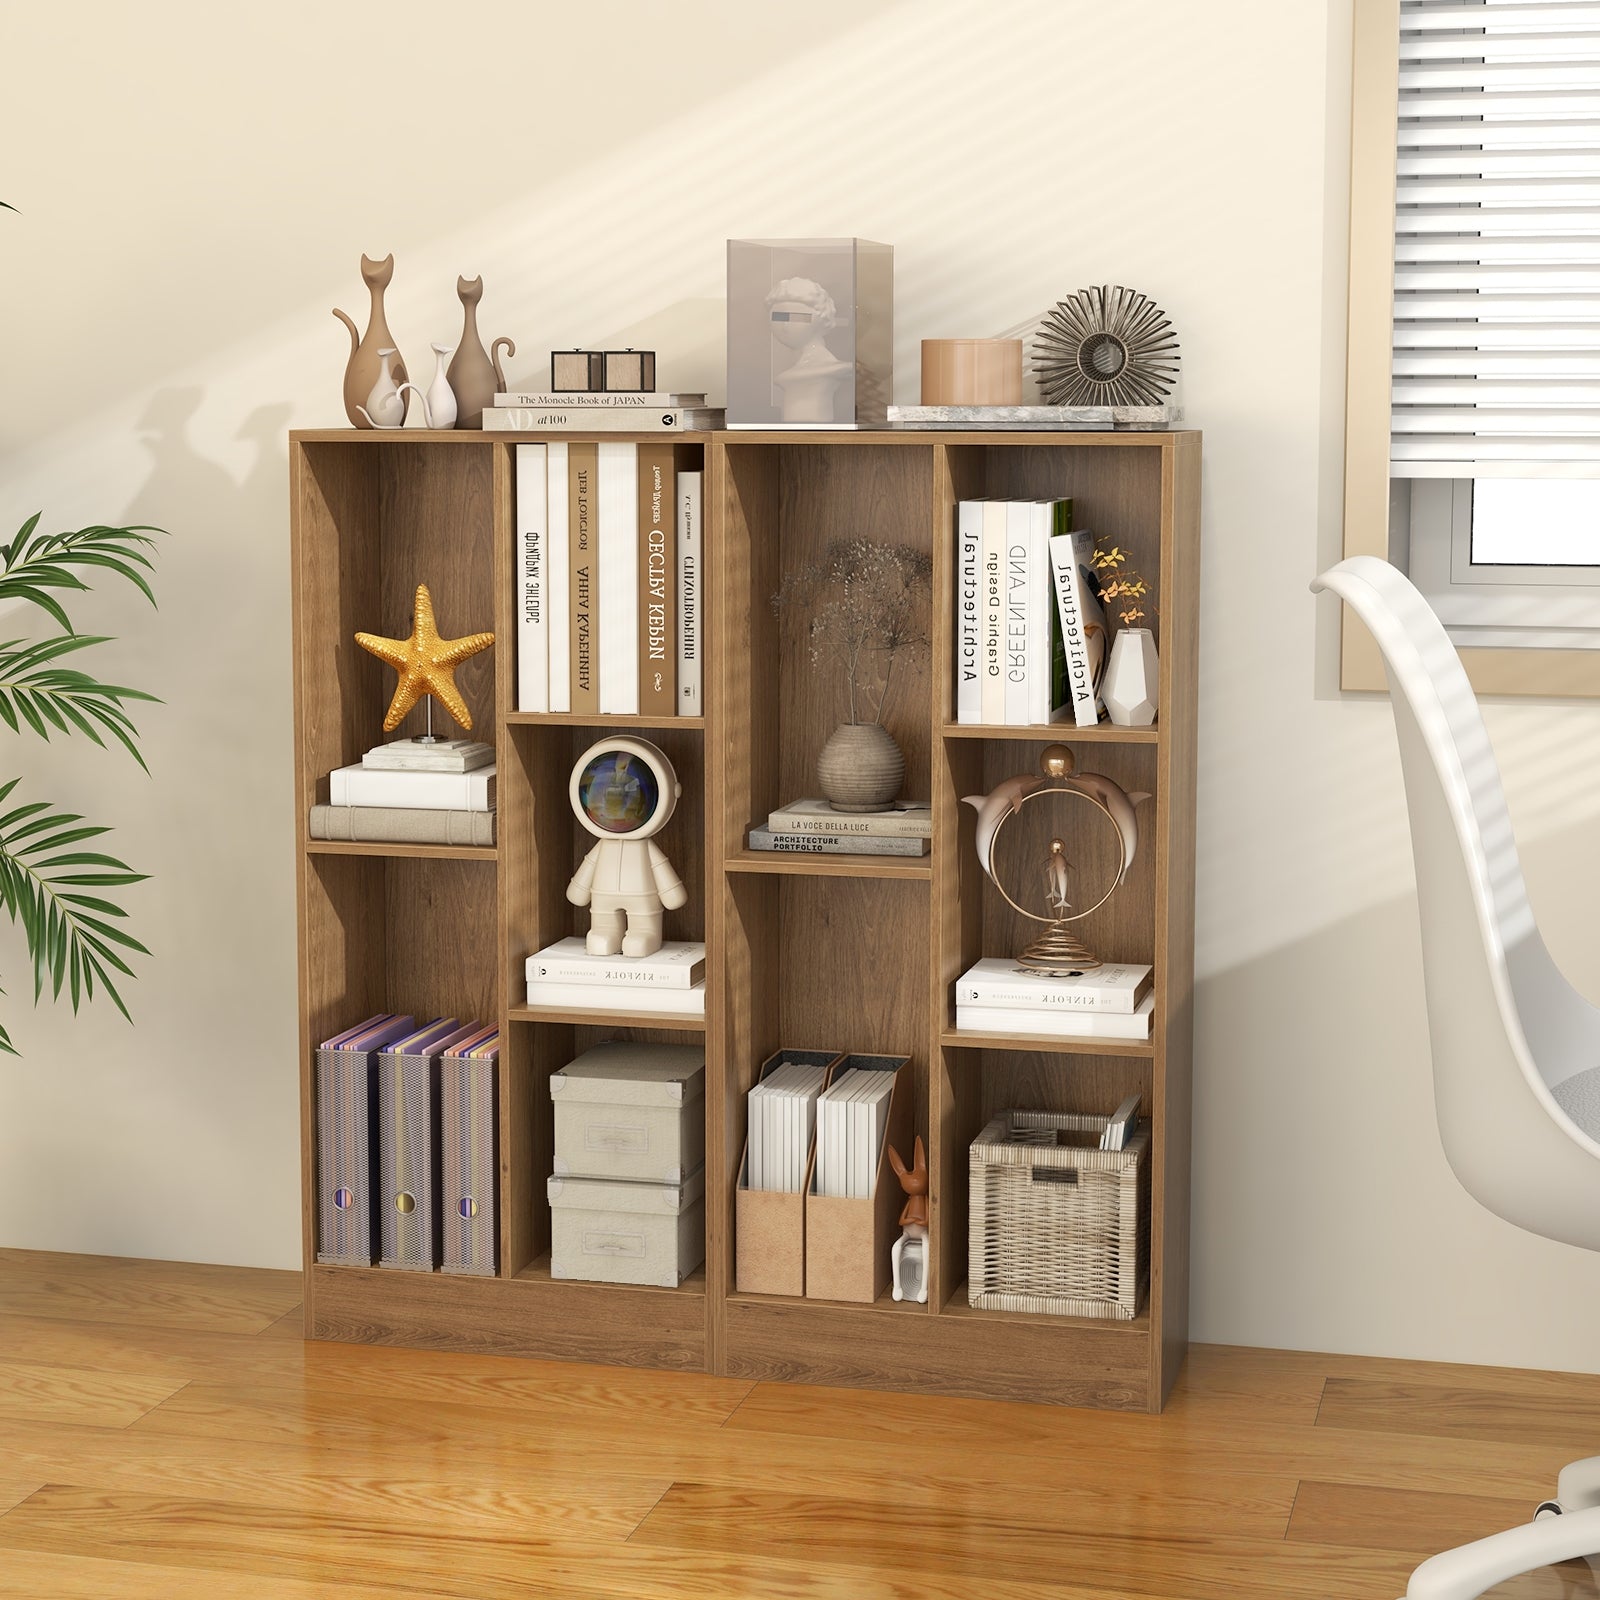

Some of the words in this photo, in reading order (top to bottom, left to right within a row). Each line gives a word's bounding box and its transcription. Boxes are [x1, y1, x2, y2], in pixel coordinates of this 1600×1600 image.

[518, 395, 536, 405] The
[538, 396, 575, 405] Monocle
[577, 396, 599, 405] Book
[601, 396, 610, 405] of
[613, 397, 645, 405] JAPAN
[505, 410, 533, 430] AD
[550, 415, 567, 425] 100
[791, 821, 801, 829] LA
[803, 822, 823, 830] VOCE
[825, 822, 849, 831] DELLA
[850, 823, 869, 832] LUCE
[773, 835, 839, 845] ARCHITECTURE
